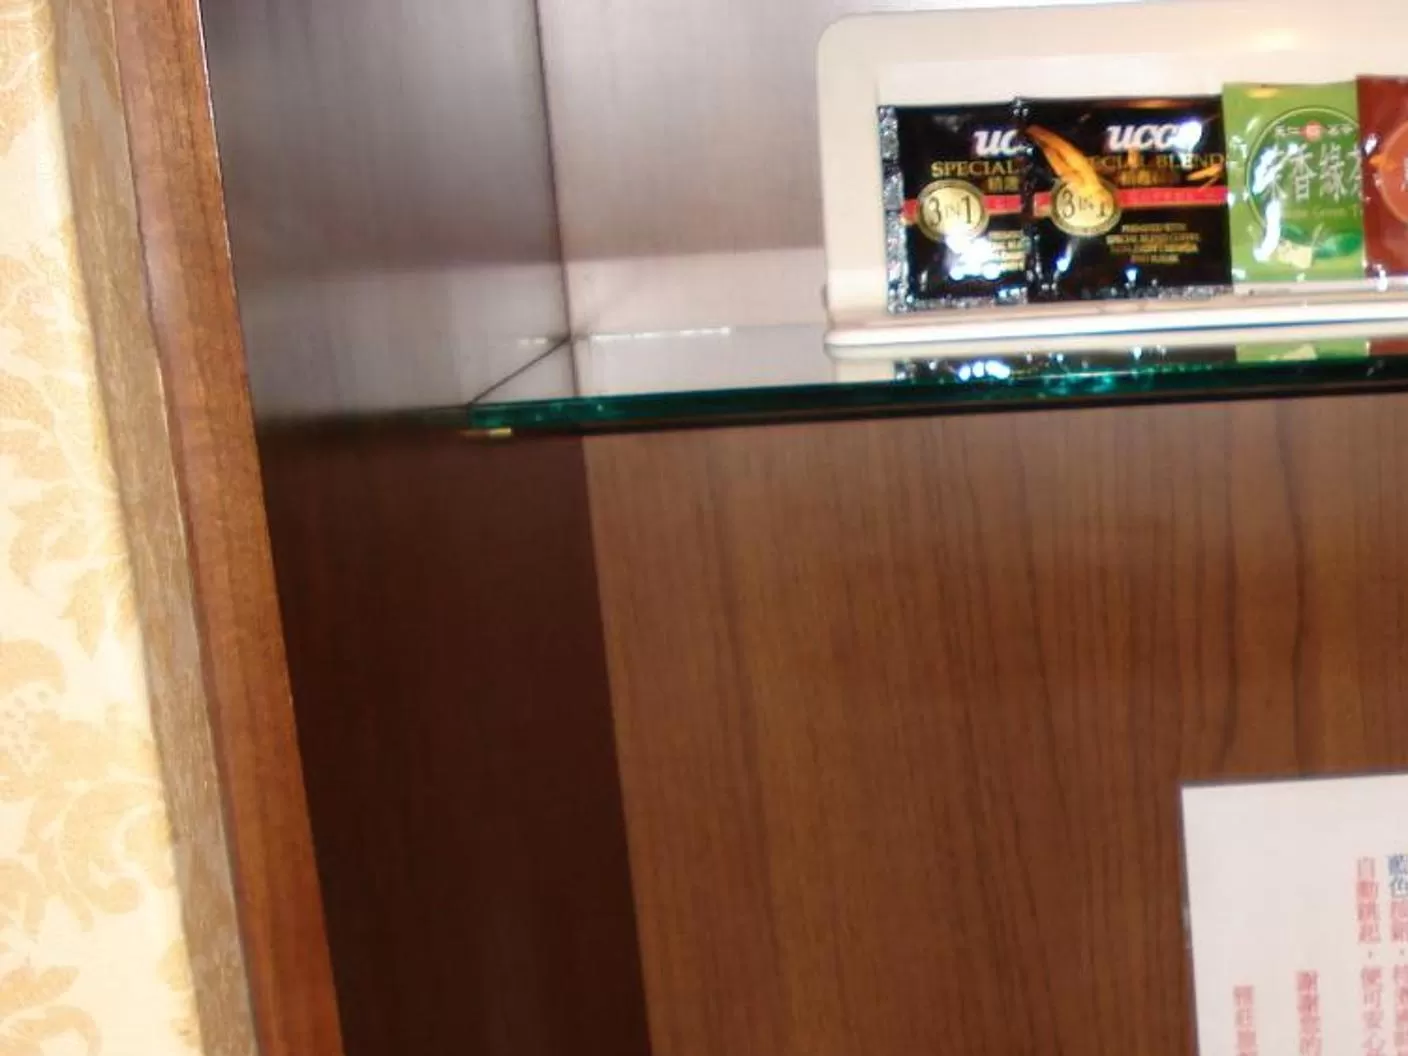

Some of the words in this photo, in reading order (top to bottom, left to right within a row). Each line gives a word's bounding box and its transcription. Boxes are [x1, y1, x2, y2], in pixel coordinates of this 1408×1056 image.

[930, 159, 1021, 178] SPECIAL
[928, 196, 942, 226] 3
[962, 195, 973, 224] 1
[1062, 188, 1076, 219] 3
